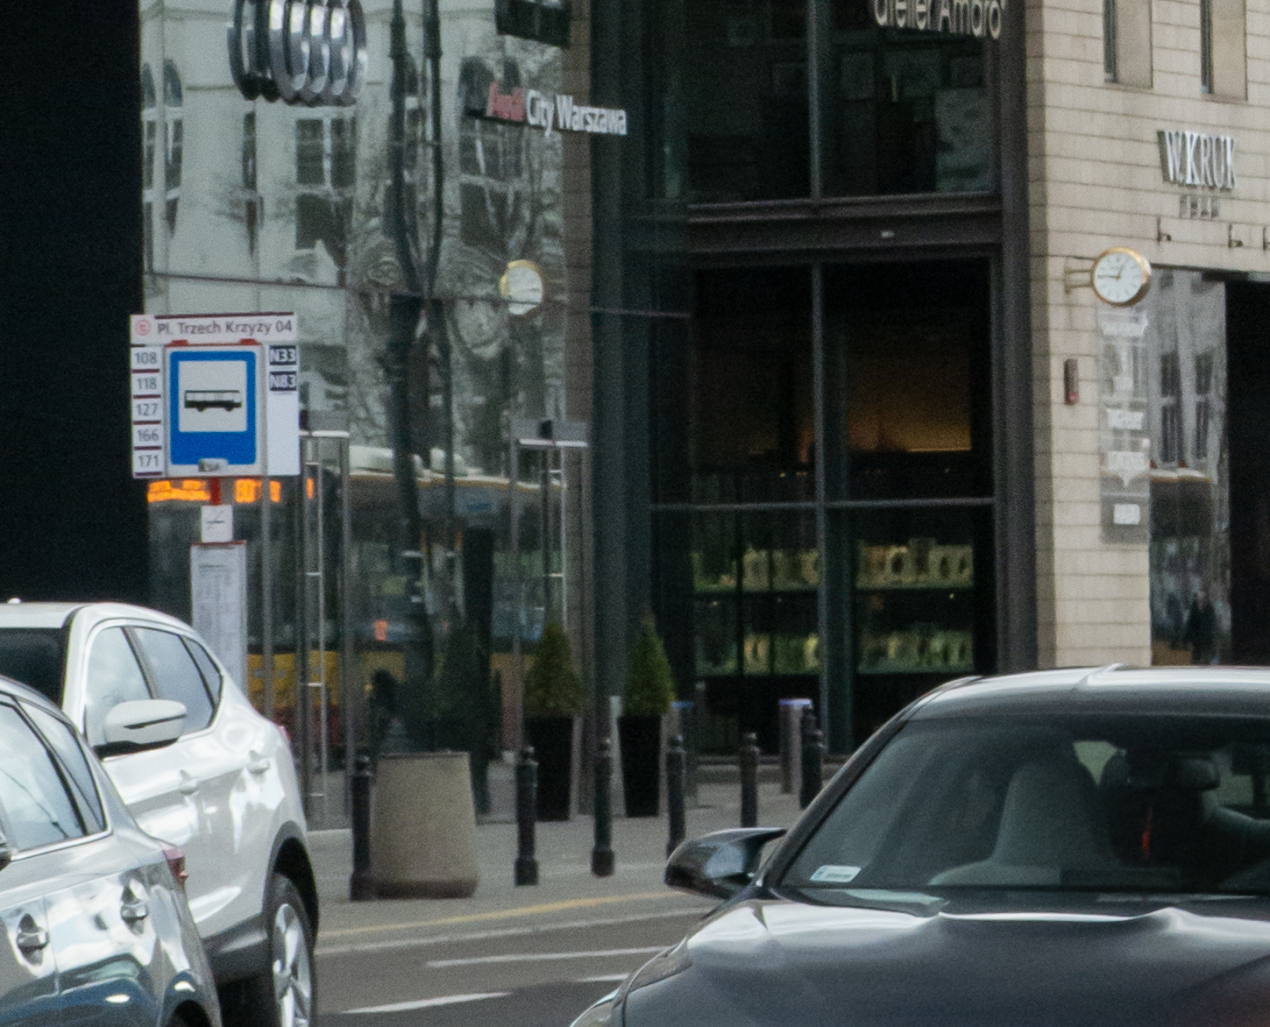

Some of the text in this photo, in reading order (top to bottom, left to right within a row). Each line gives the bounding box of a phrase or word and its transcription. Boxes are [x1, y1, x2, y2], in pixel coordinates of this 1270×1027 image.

[527, 88, 555, 137] City
[556, 94, 628, 136] Warszawa
[178, 320, 221, 335] Trzech
[275, 319, 293, 333] 04
[135, 352, 158, 365] 108
[269, 348, 296, 363] N33
[137, 377, 158, 390] 118
[136, 403, 158, 417] 127
[137, 428, 159, 442] 166
[138, 455, 159, 468] 171
